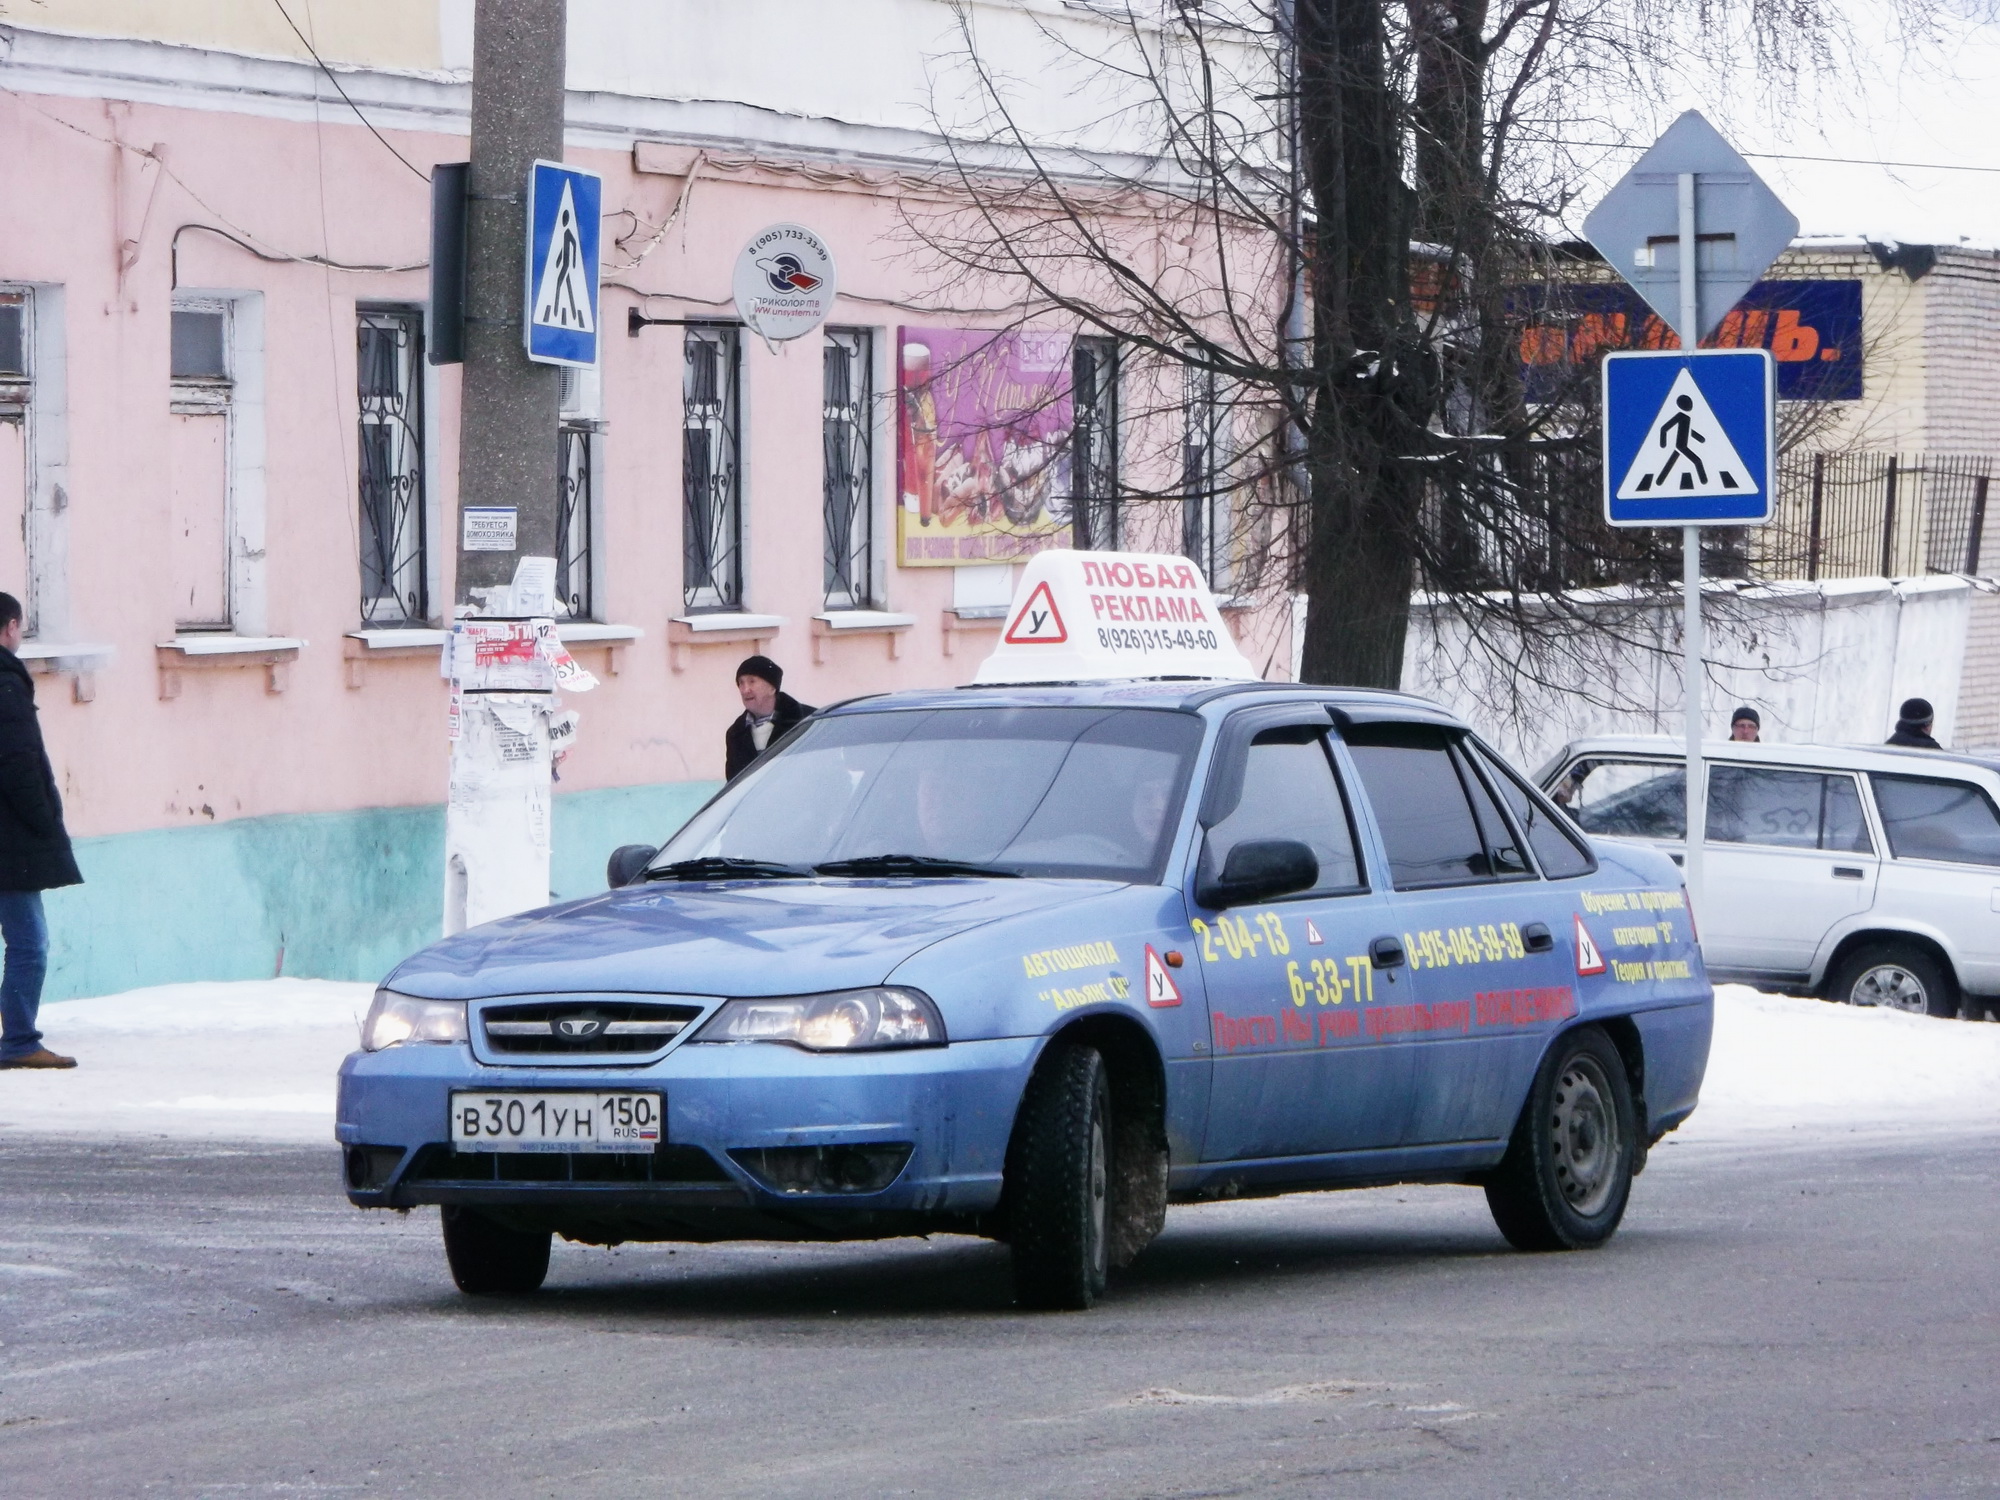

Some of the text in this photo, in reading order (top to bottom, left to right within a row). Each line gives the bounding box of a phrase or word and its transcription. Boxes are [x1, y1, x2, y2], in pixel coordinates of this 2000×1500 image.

[748, 230, 827, 261] 8 (905) 733-33-99
[471, 521, 508, 529] ТРЕБУЕТСЯ
[1081, 561, 1198, 590] ЛЮБАЯ
[1090, 594, 1209, 623] РЕКЛАМА
[1097, 627, 1218, 654] 8(926)315-49-60
[1580, 891, 1628, 916] Обучение
[1626, 893, 1641, 910] по
[1191, 911, 1290, 962] 2-04-13
[1404, 922, 1525, 970] 8-915-045-59-59
[1613, 926, 1658, 948] категории
[1022, 941, 1120, 979] АВТОШКОЛА
[1610, 959, 1647, 985] Теория
[1645, 962, 1654, 979] и
[1287, 956, 1373, 1007] 6-33-77
[1212, 1011, 1276, 1053] Просто
[1281, 1007, 1313, 1041] Мы
[1318, 1010, 1359, 1047] учим
[1365, 999, 1470, 1041] правильному
[602, 1097, 651, 1126] 150
[614, 1128, 639, 1138] RUS
